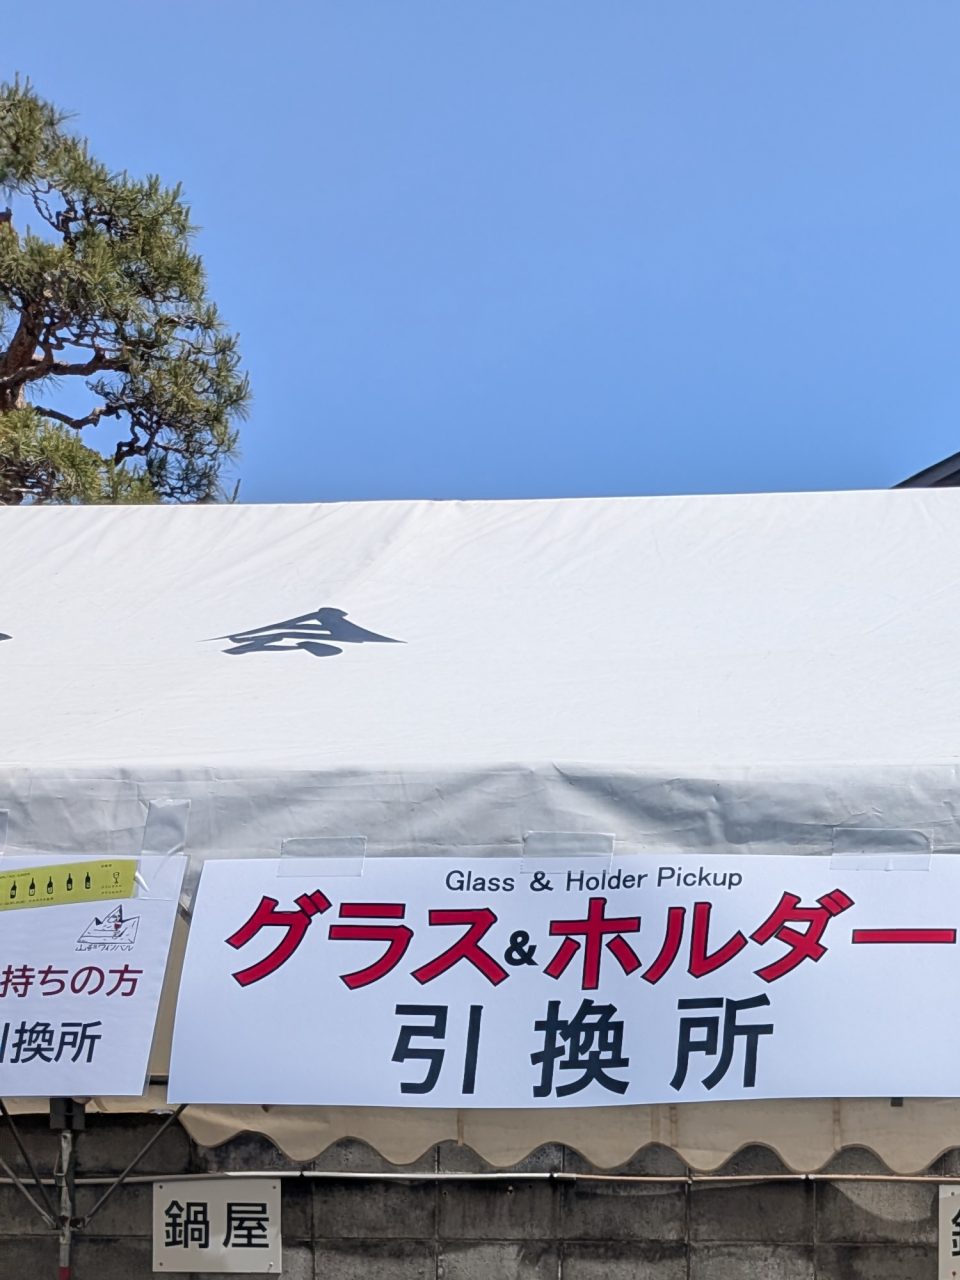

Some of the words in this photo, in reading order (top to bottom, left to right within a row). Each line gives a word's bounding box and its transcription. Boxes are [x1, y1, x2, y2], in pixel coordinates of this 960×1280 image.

[446, 869, 515, 892] Glass
[530, 870, 554, 892] &
[566, 868, 648, 892] Holder
[656, 866, 743, 890] Pickup
[225, 888, 957, 991] グラス&ホルダー
[0, 964, 144, 998] 持ちの方
[164, 1199, 270, 1249] 鍋屋
